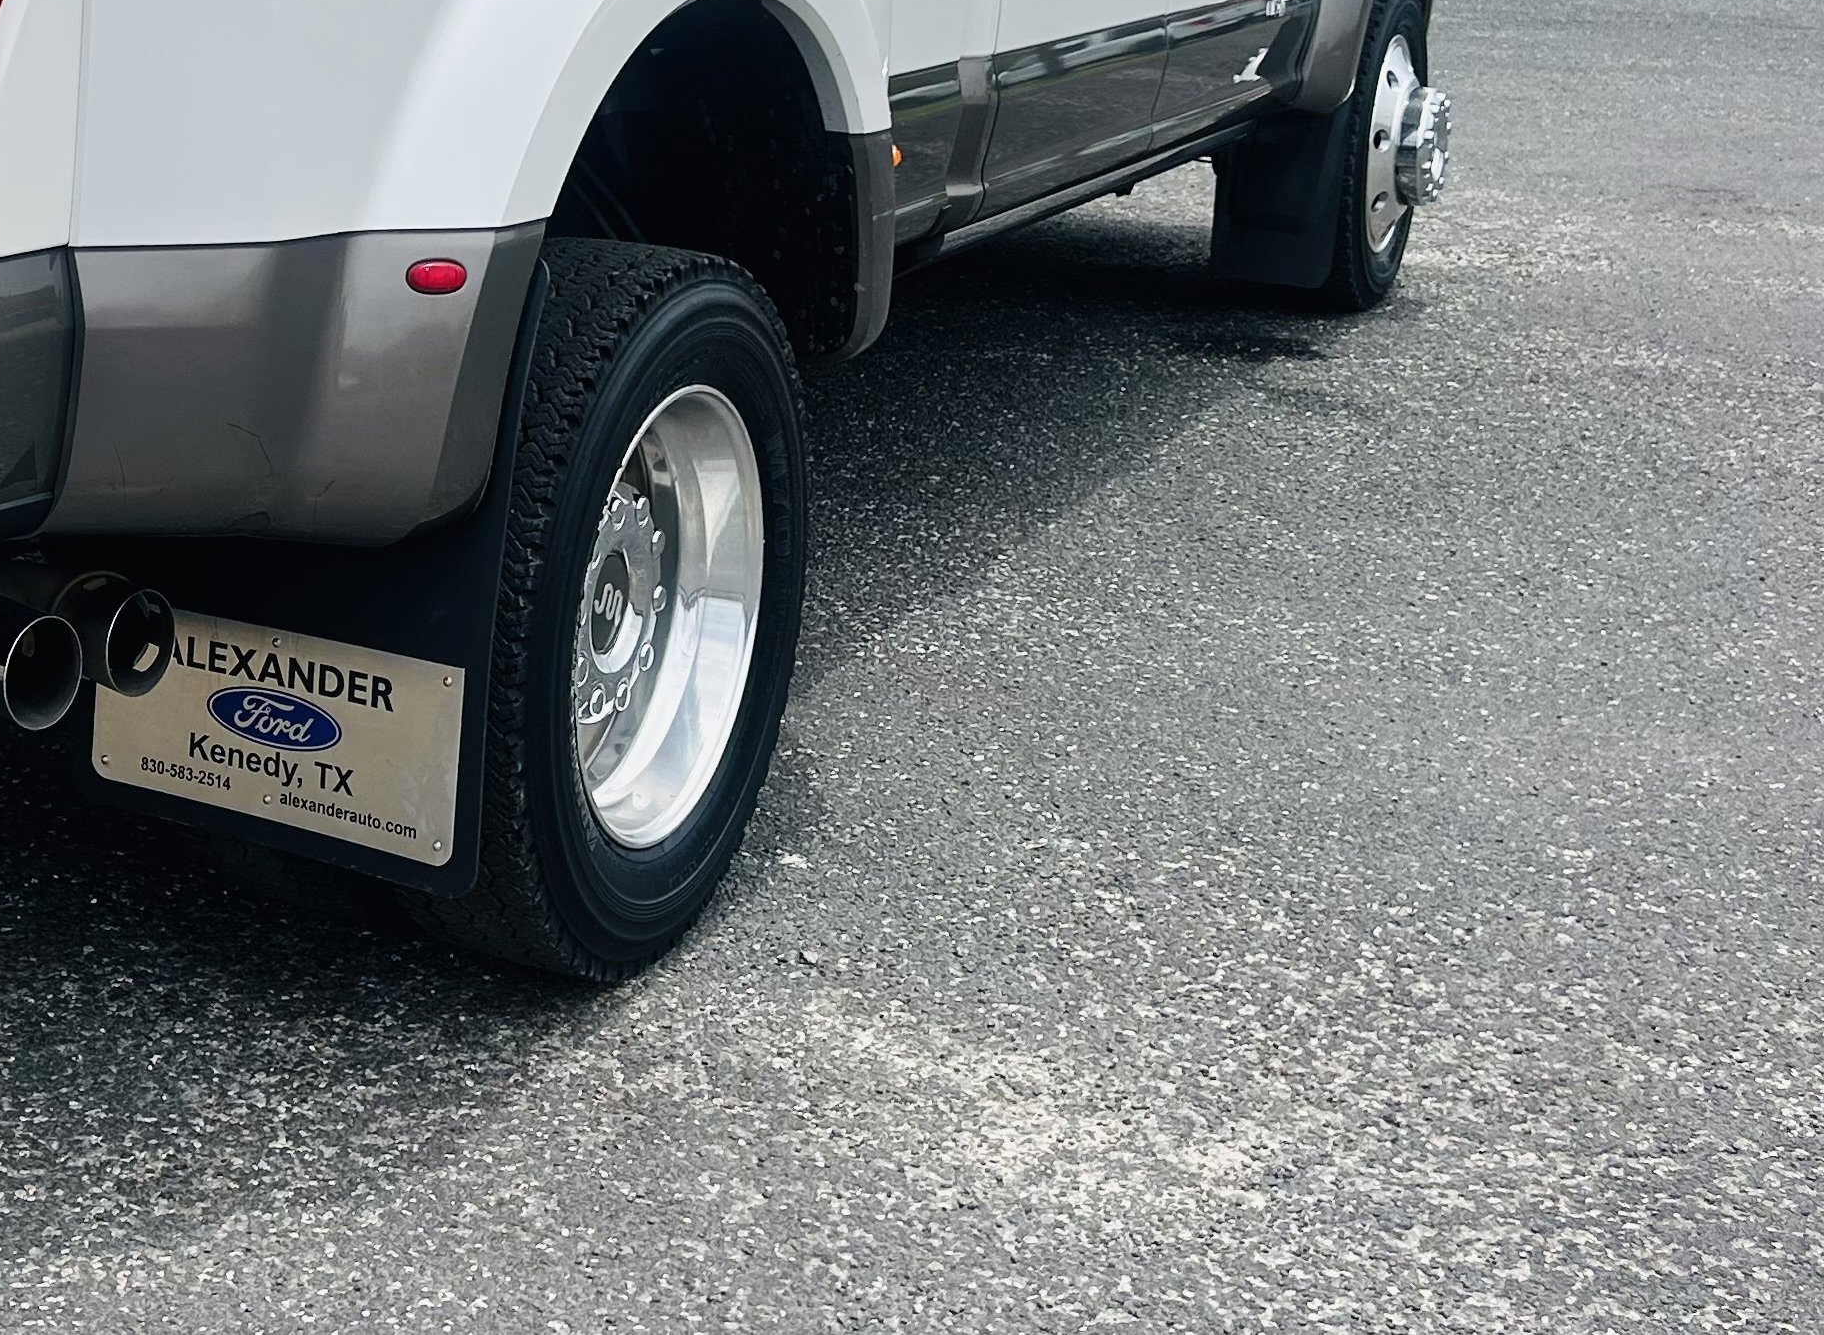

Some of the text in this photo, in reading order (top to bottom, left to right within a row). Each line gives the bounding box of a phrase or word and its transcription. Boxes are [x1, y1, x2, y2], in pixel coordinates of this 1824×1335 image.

[232, 693, 316, 745] Ford
[140, 757, 231, 791] 830-583-2514
[187, 732, 354, 797] Kenedy, TX
[279, 792, 417, 839] alexanderauto.com
